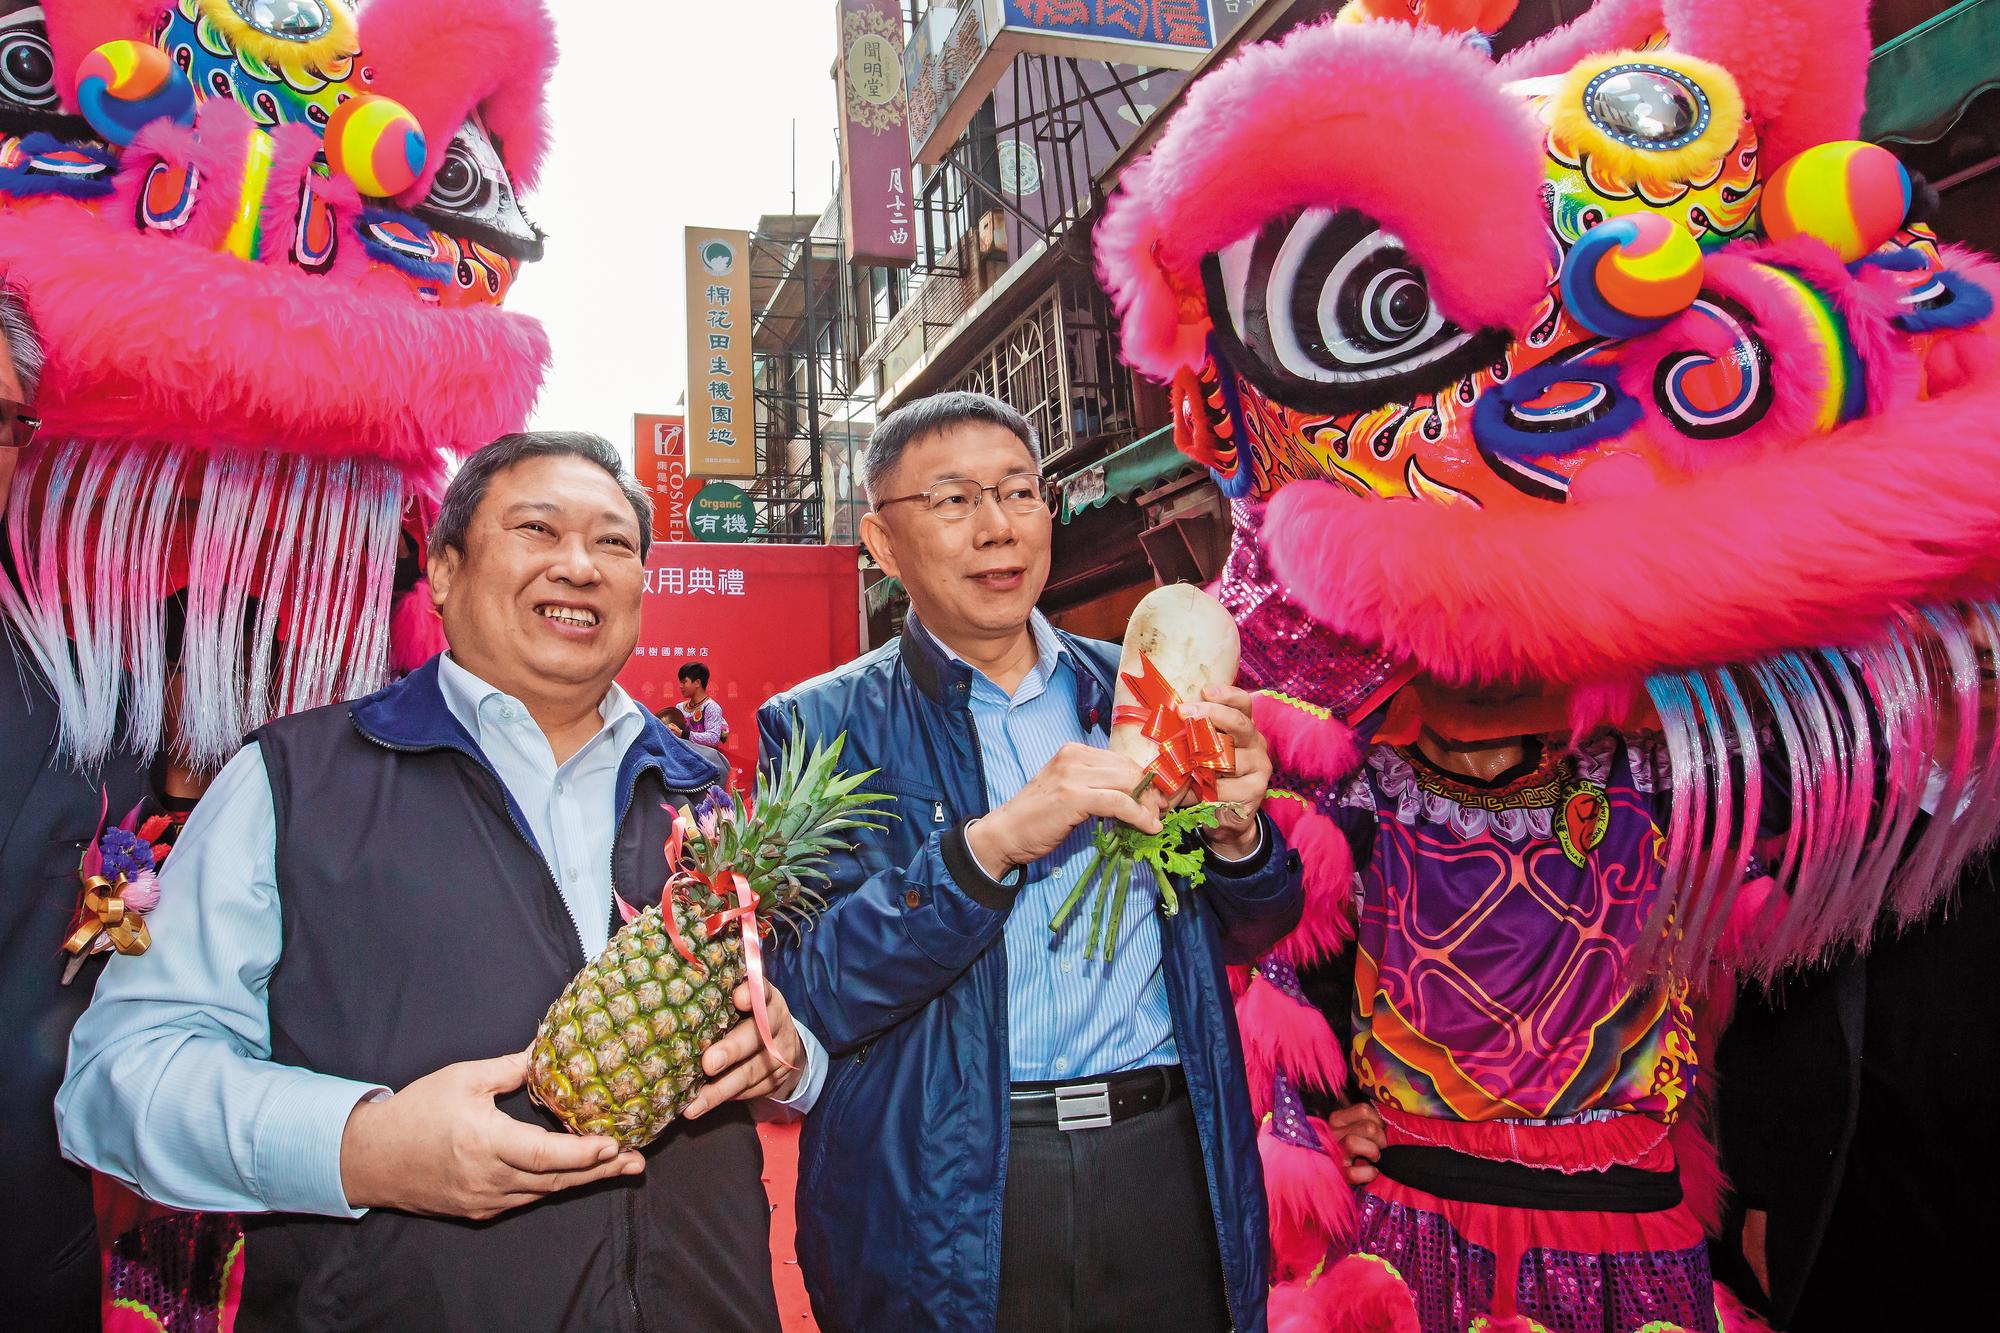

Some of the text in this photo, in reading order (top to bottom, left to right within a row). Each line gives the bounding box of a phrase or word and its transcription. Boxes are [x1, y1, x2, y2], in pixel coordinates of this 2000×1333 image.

[706, 285, 736, 446] 棉花田生機園地
[669, 461, 684, 543] COSMED
[699, 498, 742, 511] Organic
[694, 513, 749, 534] 有機
[635, 647, 709, 657] 阿樹國際旅店
